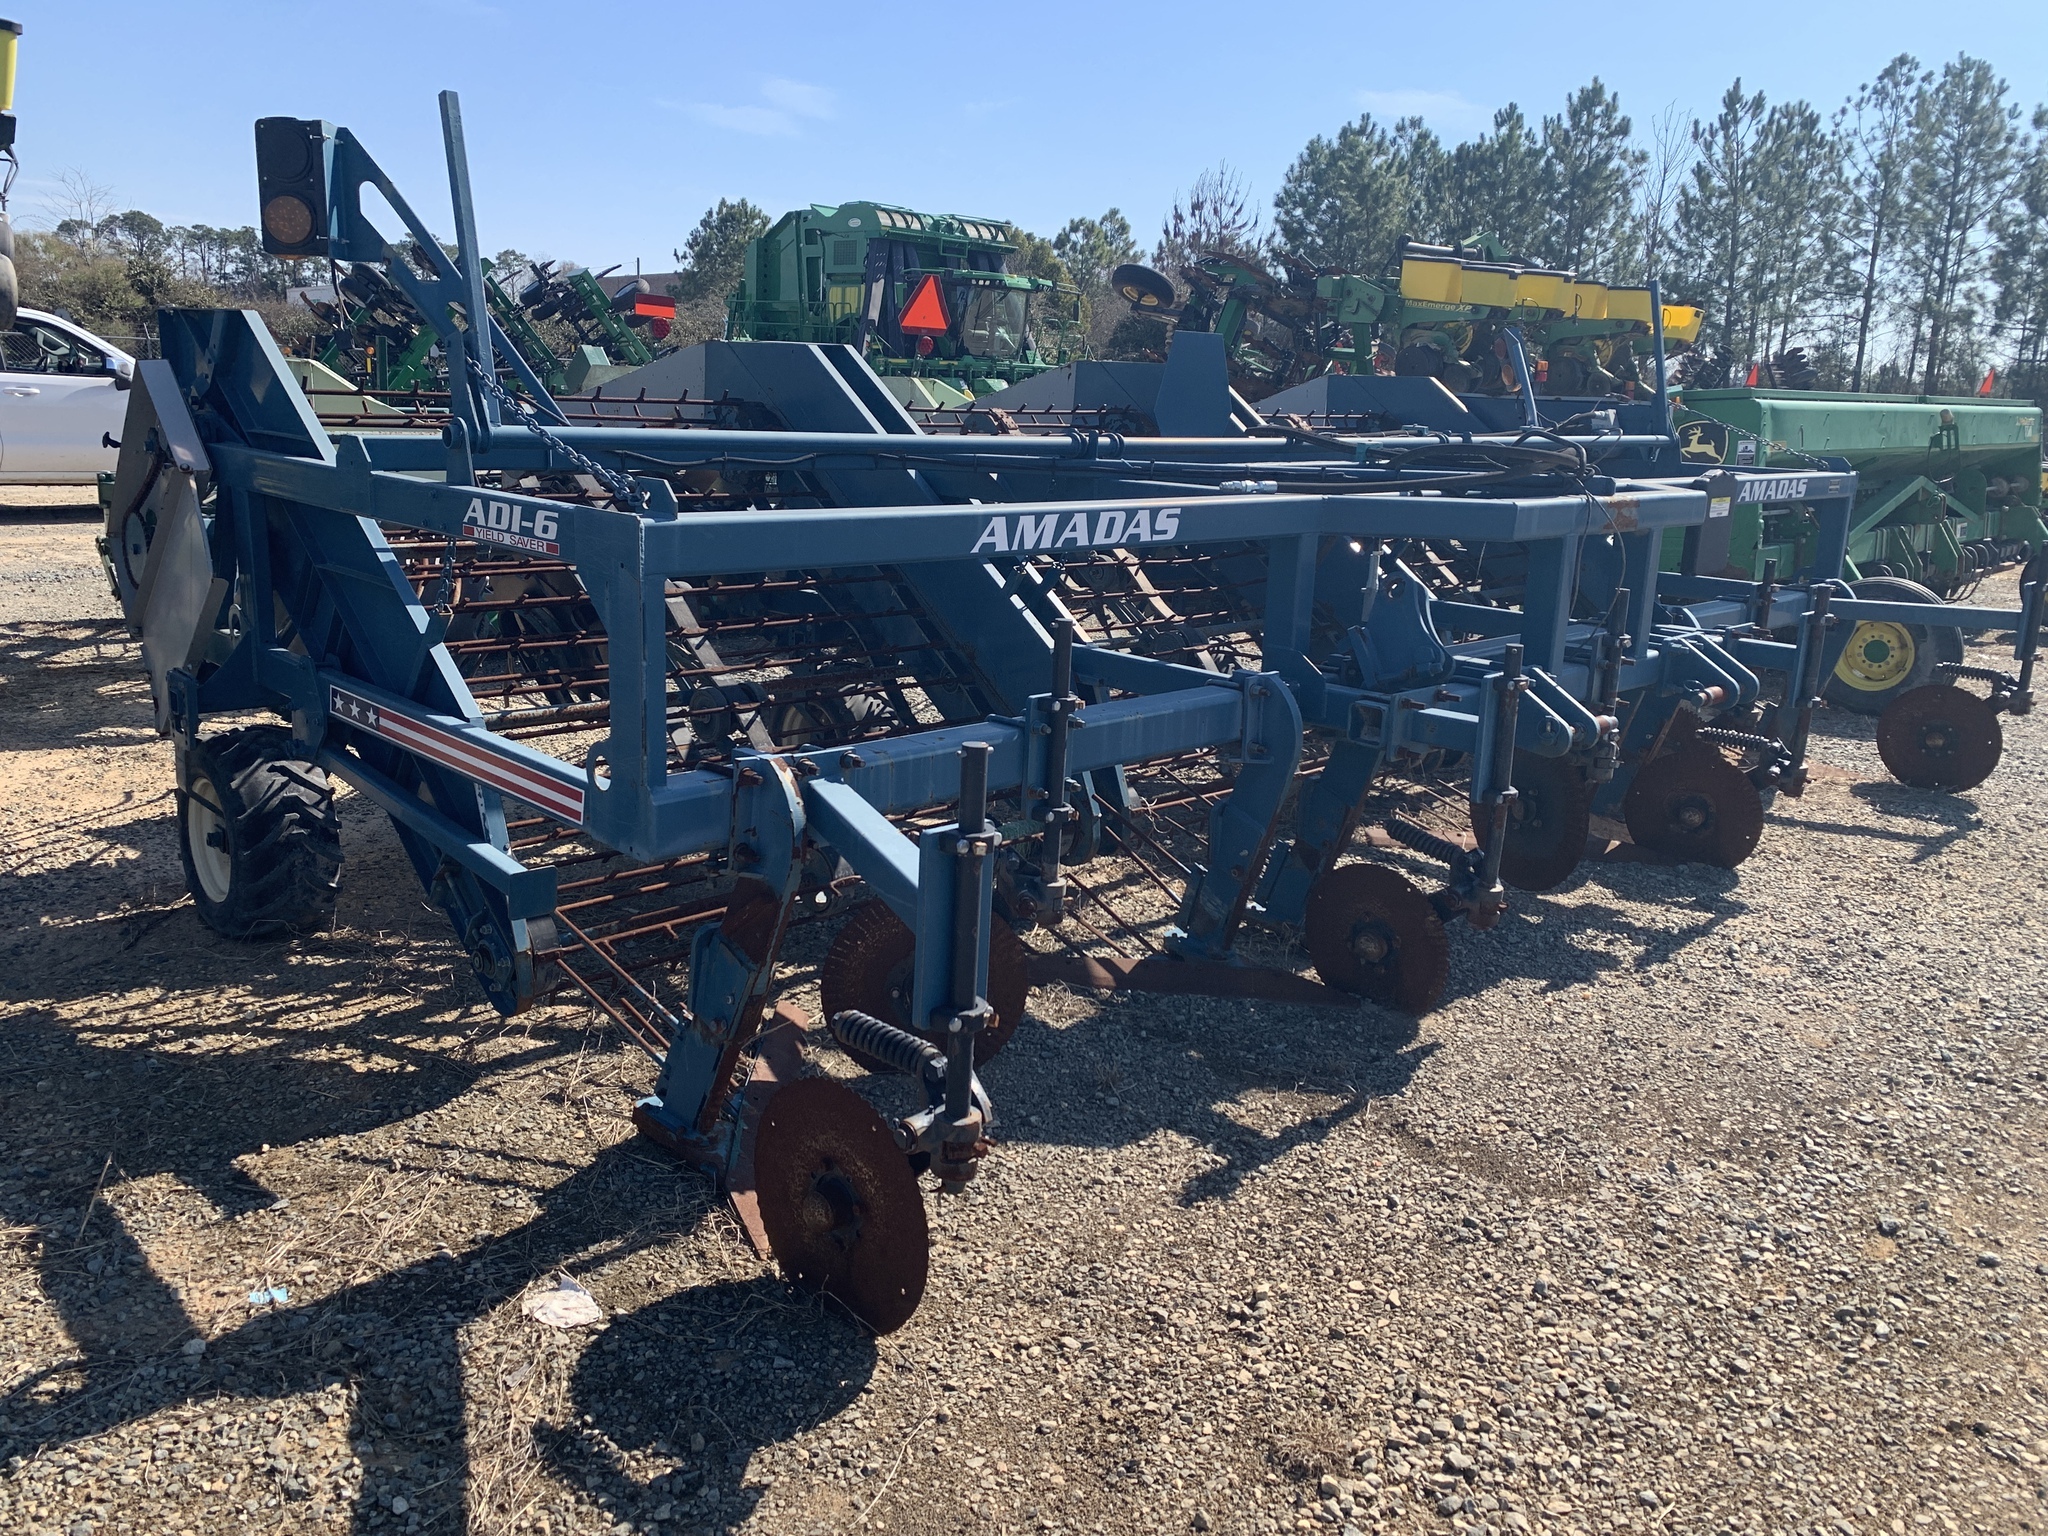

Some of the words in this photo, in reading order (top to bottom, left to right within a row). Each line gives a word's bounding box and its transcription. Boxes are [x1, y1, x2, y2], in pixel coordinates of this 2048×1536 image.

[1405, 300, 1456, 311] MaxEmerge
[1456, 304, 1473, 312] XP
[1737, 478, 1808, 503] AMADAS
[463, 497, 559, 540] ADI-6
[969, 507, 1182, 554] AMADAS
[476, 527, 504, 542] YIELD
[510, 536, 544, 551] SAVER
